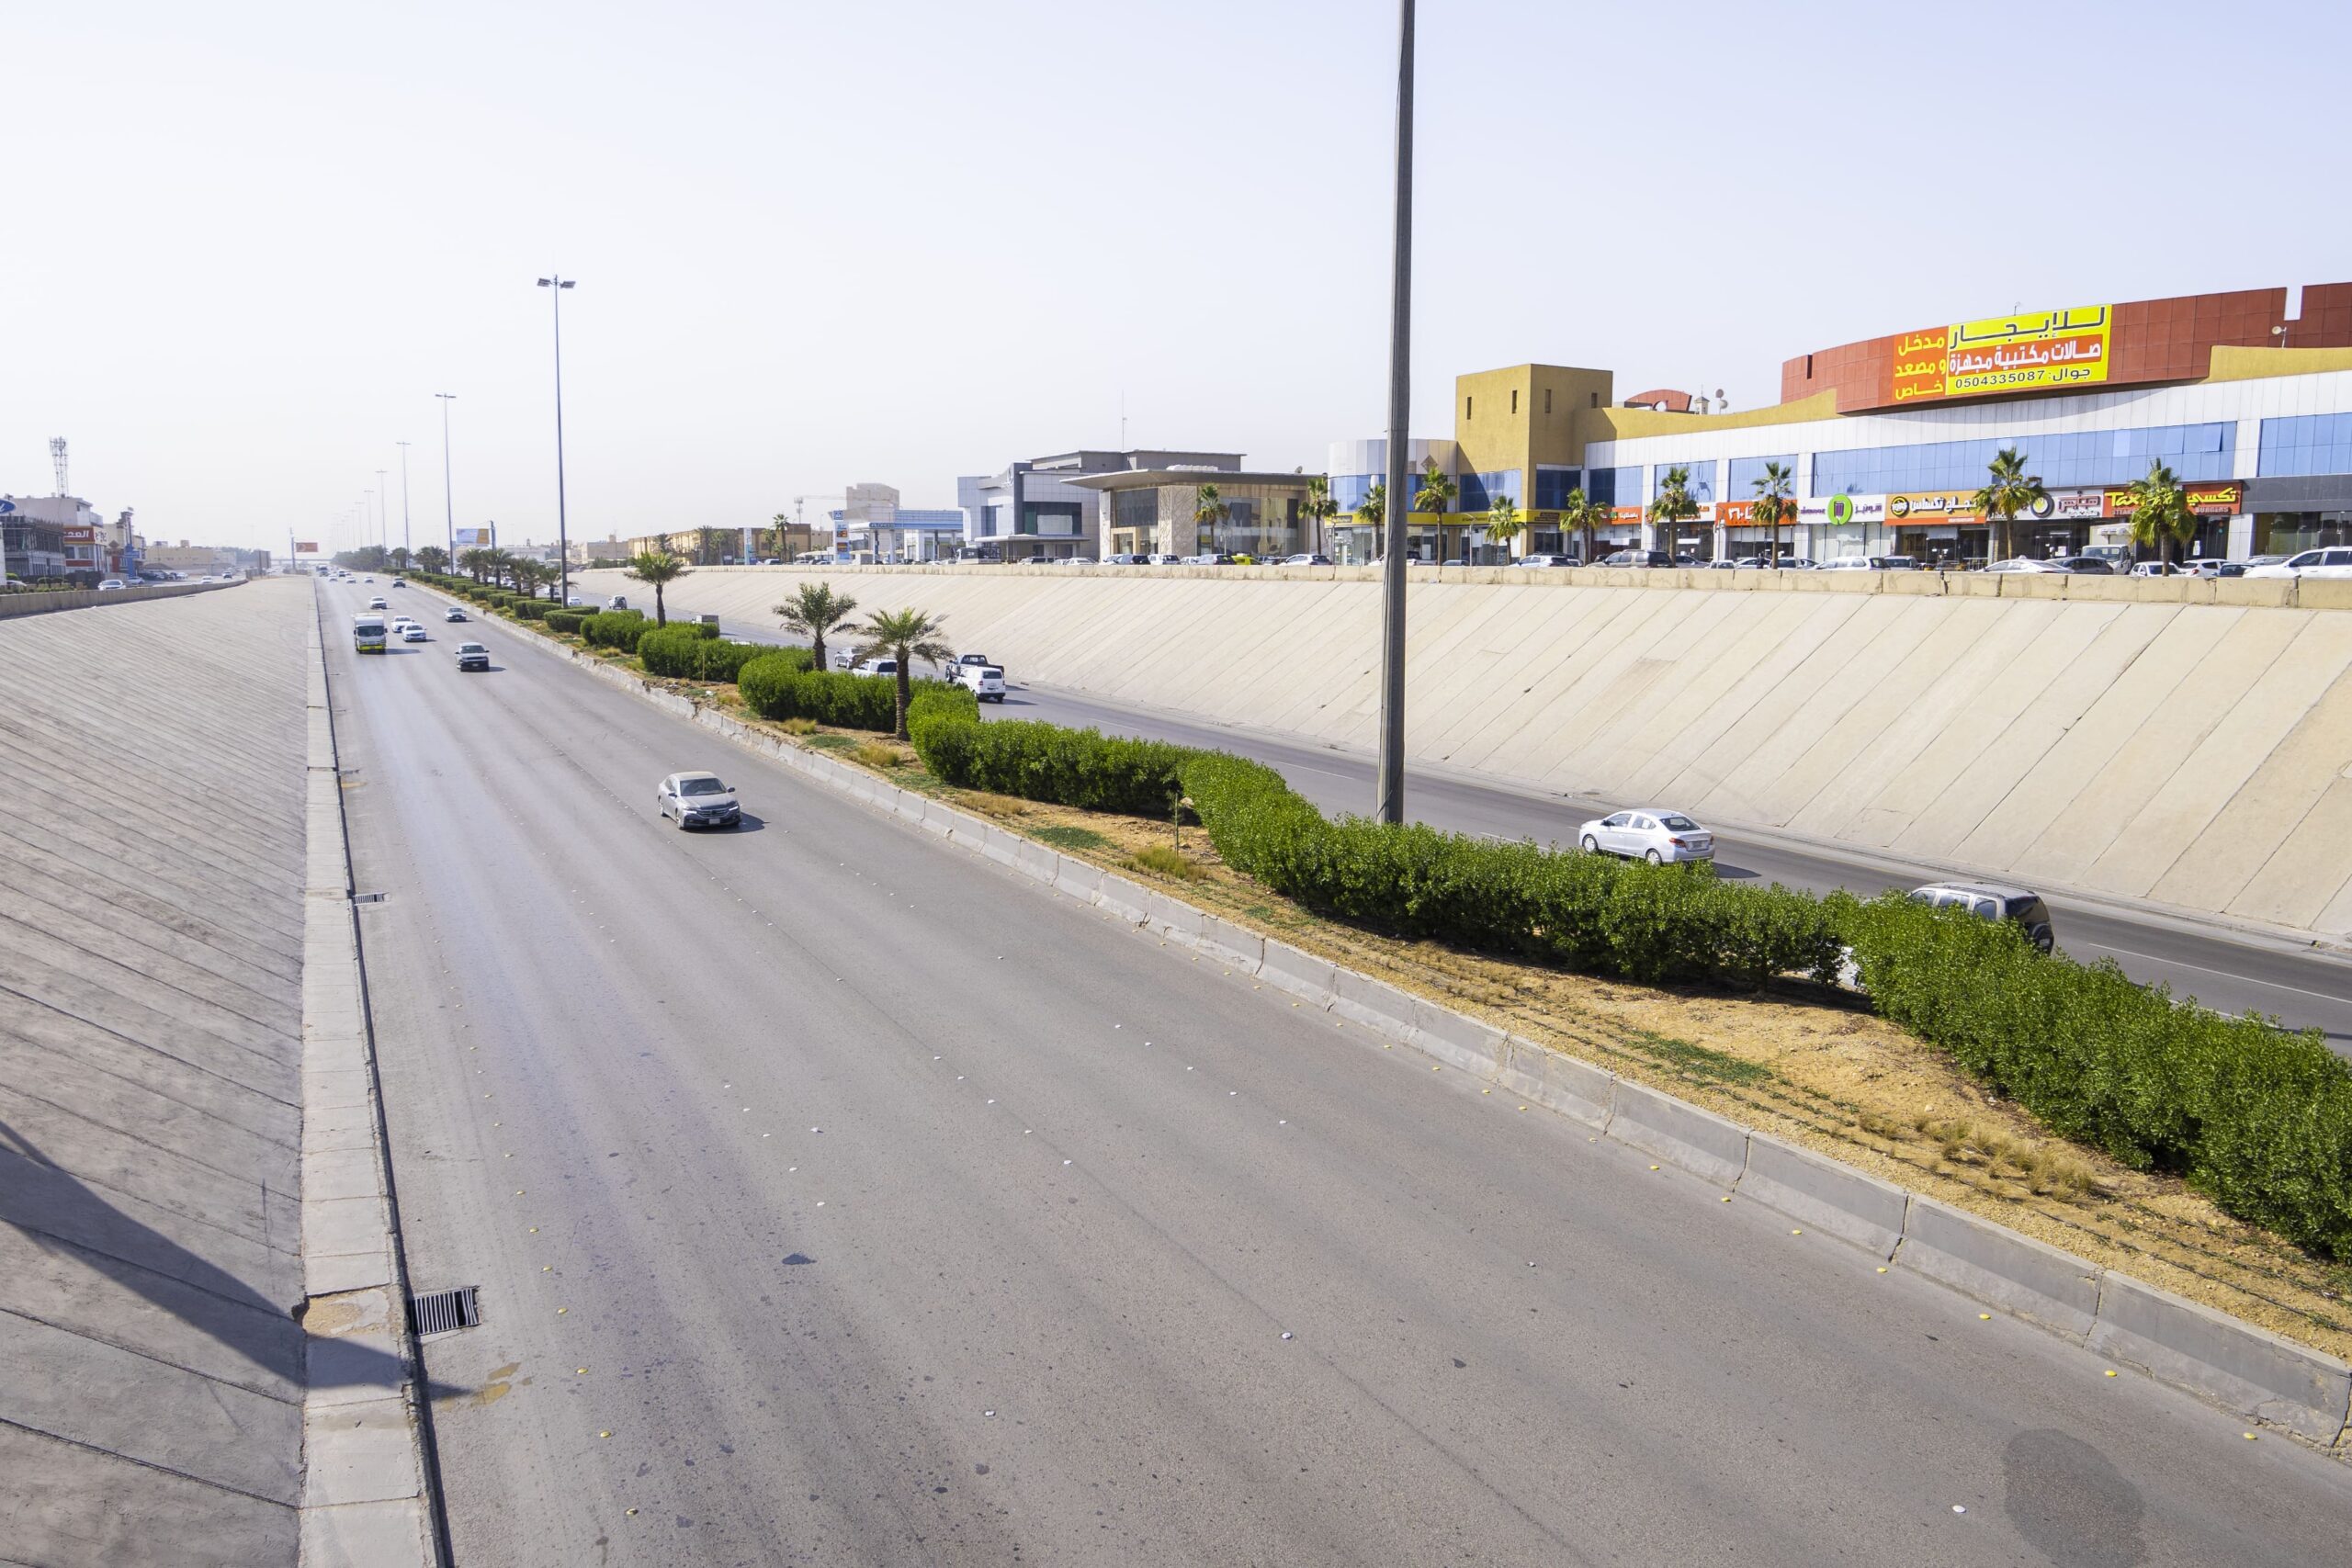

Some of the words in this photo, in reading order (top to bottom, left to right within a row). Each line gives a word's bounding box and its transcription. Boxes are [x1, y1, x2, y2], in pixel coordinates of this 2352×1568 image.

[1897, 333, 1945, 357] مدخل
[2051, 340, 2102, 361] صالات
[1938, 359, 1947, 375] و
[1949, 353, 1993, 377] مجهزة
[1994, 344, 2050, 371] مكتبية
[1894, 364, 1937, 378] مصعد
[1955, 369, 2045, 389] 0504335087
[1895, 379, 1944, 401] خاص
[2186, 487, 2236, 506] تكسي
